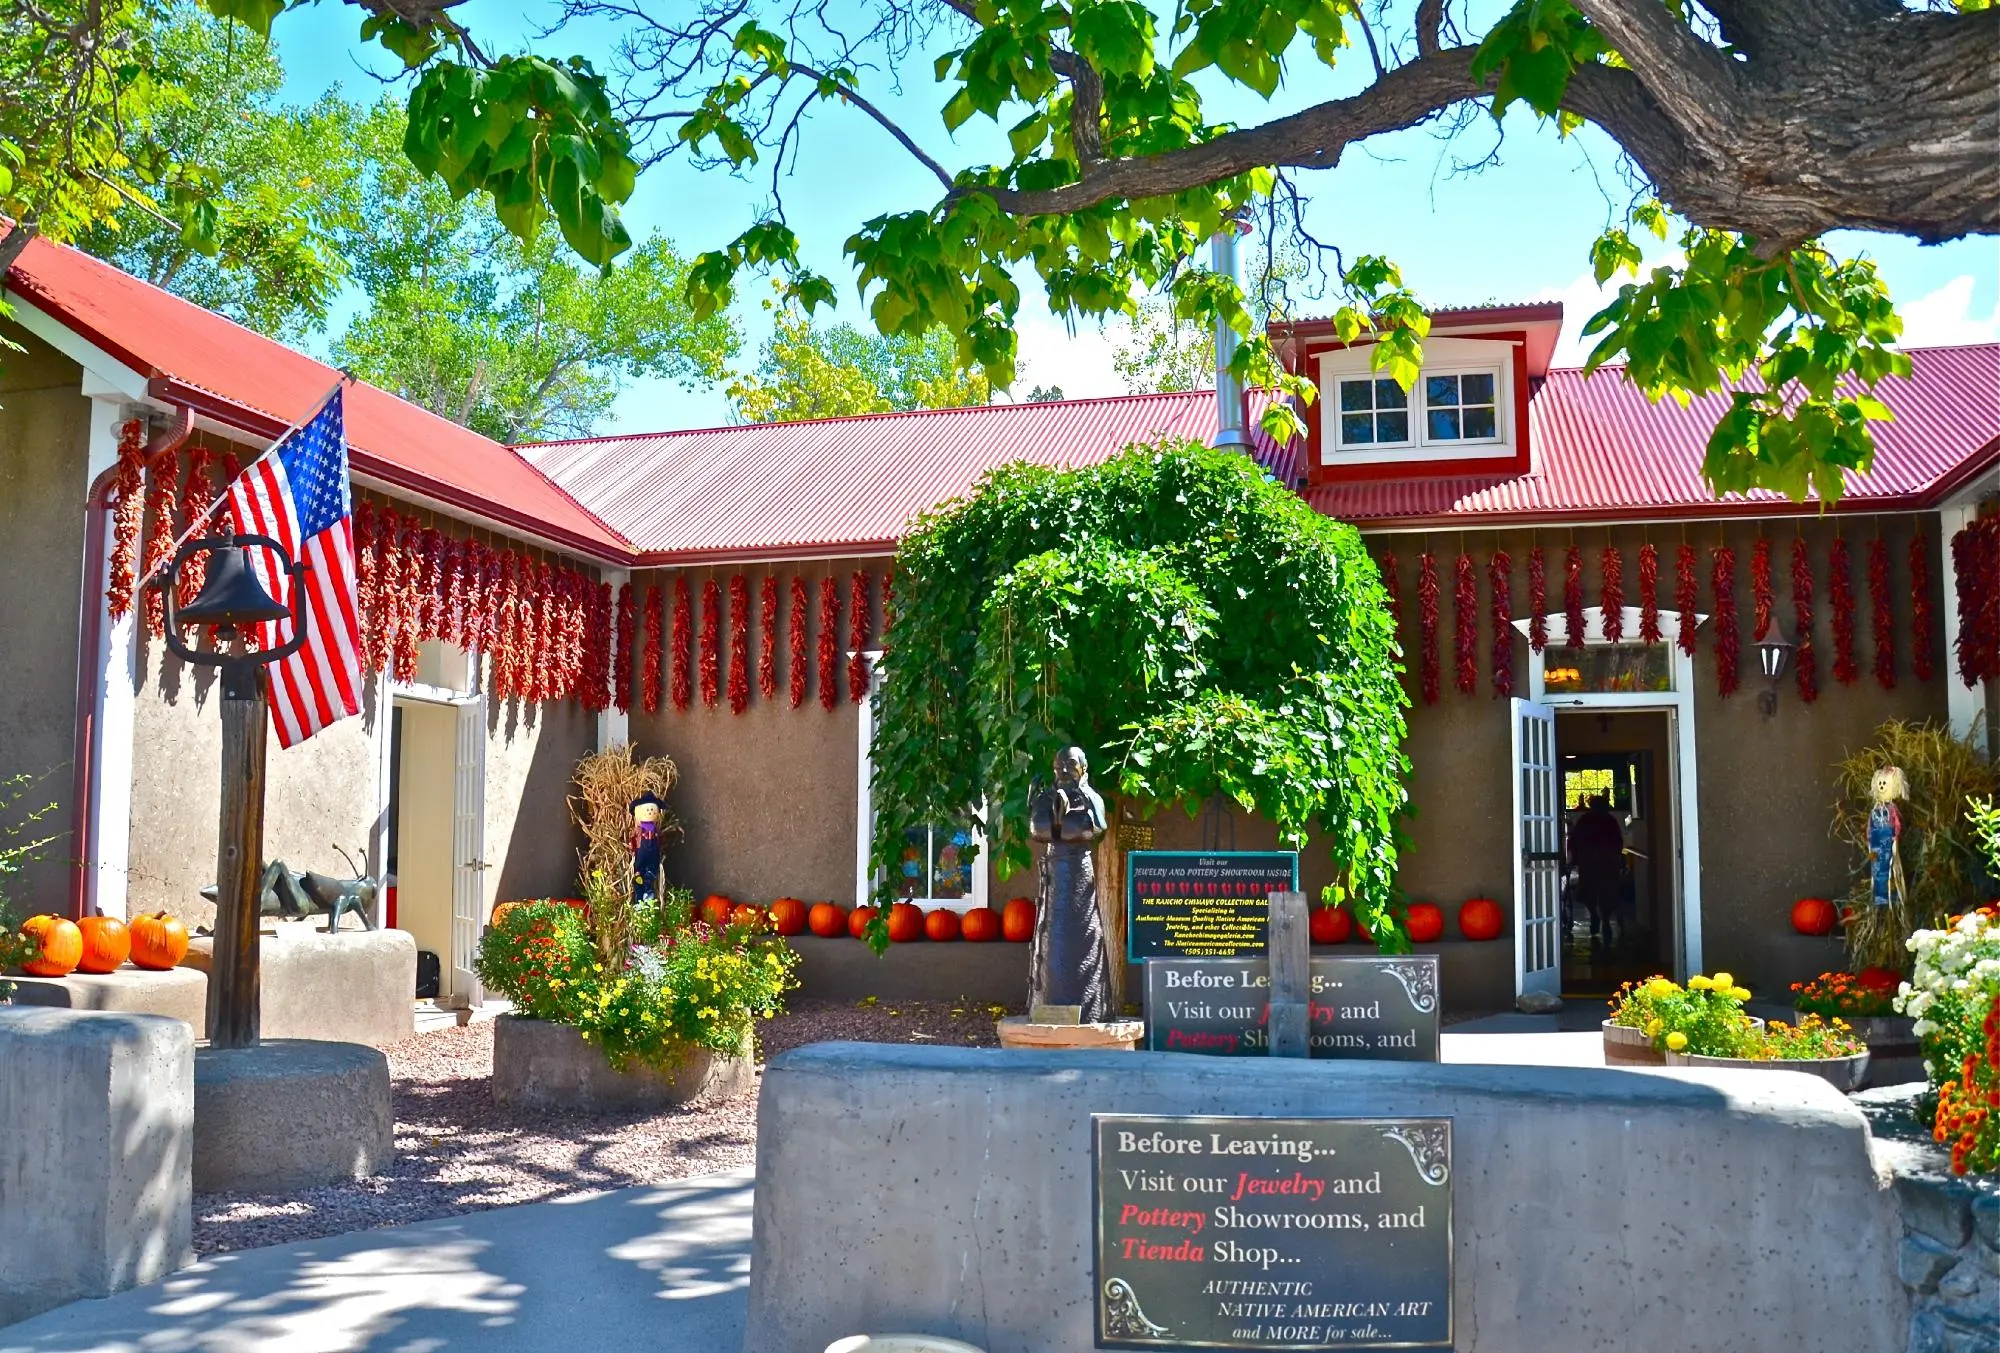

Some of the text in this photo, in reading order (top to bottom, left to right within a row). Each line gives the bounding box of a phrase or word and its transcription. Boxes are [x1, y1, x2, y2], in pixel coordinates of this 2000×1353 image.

[1199, 858, 1215, 866] Visit
[1134, 868, 1292, 878] JEWELRY AND POTTERY SHOWROOM INSIDE
[1155, 898, 1183, 906] RANCHO
[1184, 898, 1214, 906] CHIMAYO
[1215, 898, 1254, 906] COLLECTION
[1192, 907, 1228, 915] Specializing
[1192, 915, 1215, 923] Quality
[1166, 970, 1343, 993] Before Leg...
[1168, 1001, 1380, 1025] Visit our Jlry and
[1167, 1027, 1417, 1052] Pottery Shooms, and
[1117, 1131, 1336, 1163] Before Leaving...
[1119, 1168, 1381, 1201] Visit our Jewelry and
[1119, 1204, 1426, 1234] Pottery Showrooms, and
[1120, 1238, 1302, 1270] Tienda Shop...
[1202, 1280, 1313, 1296] AUTHENTIC
[1218, 1301, 1433, 1318] NATIVE AMERICAN ART
[1232, 1324, 1393, 1344] and MORE for sale...
